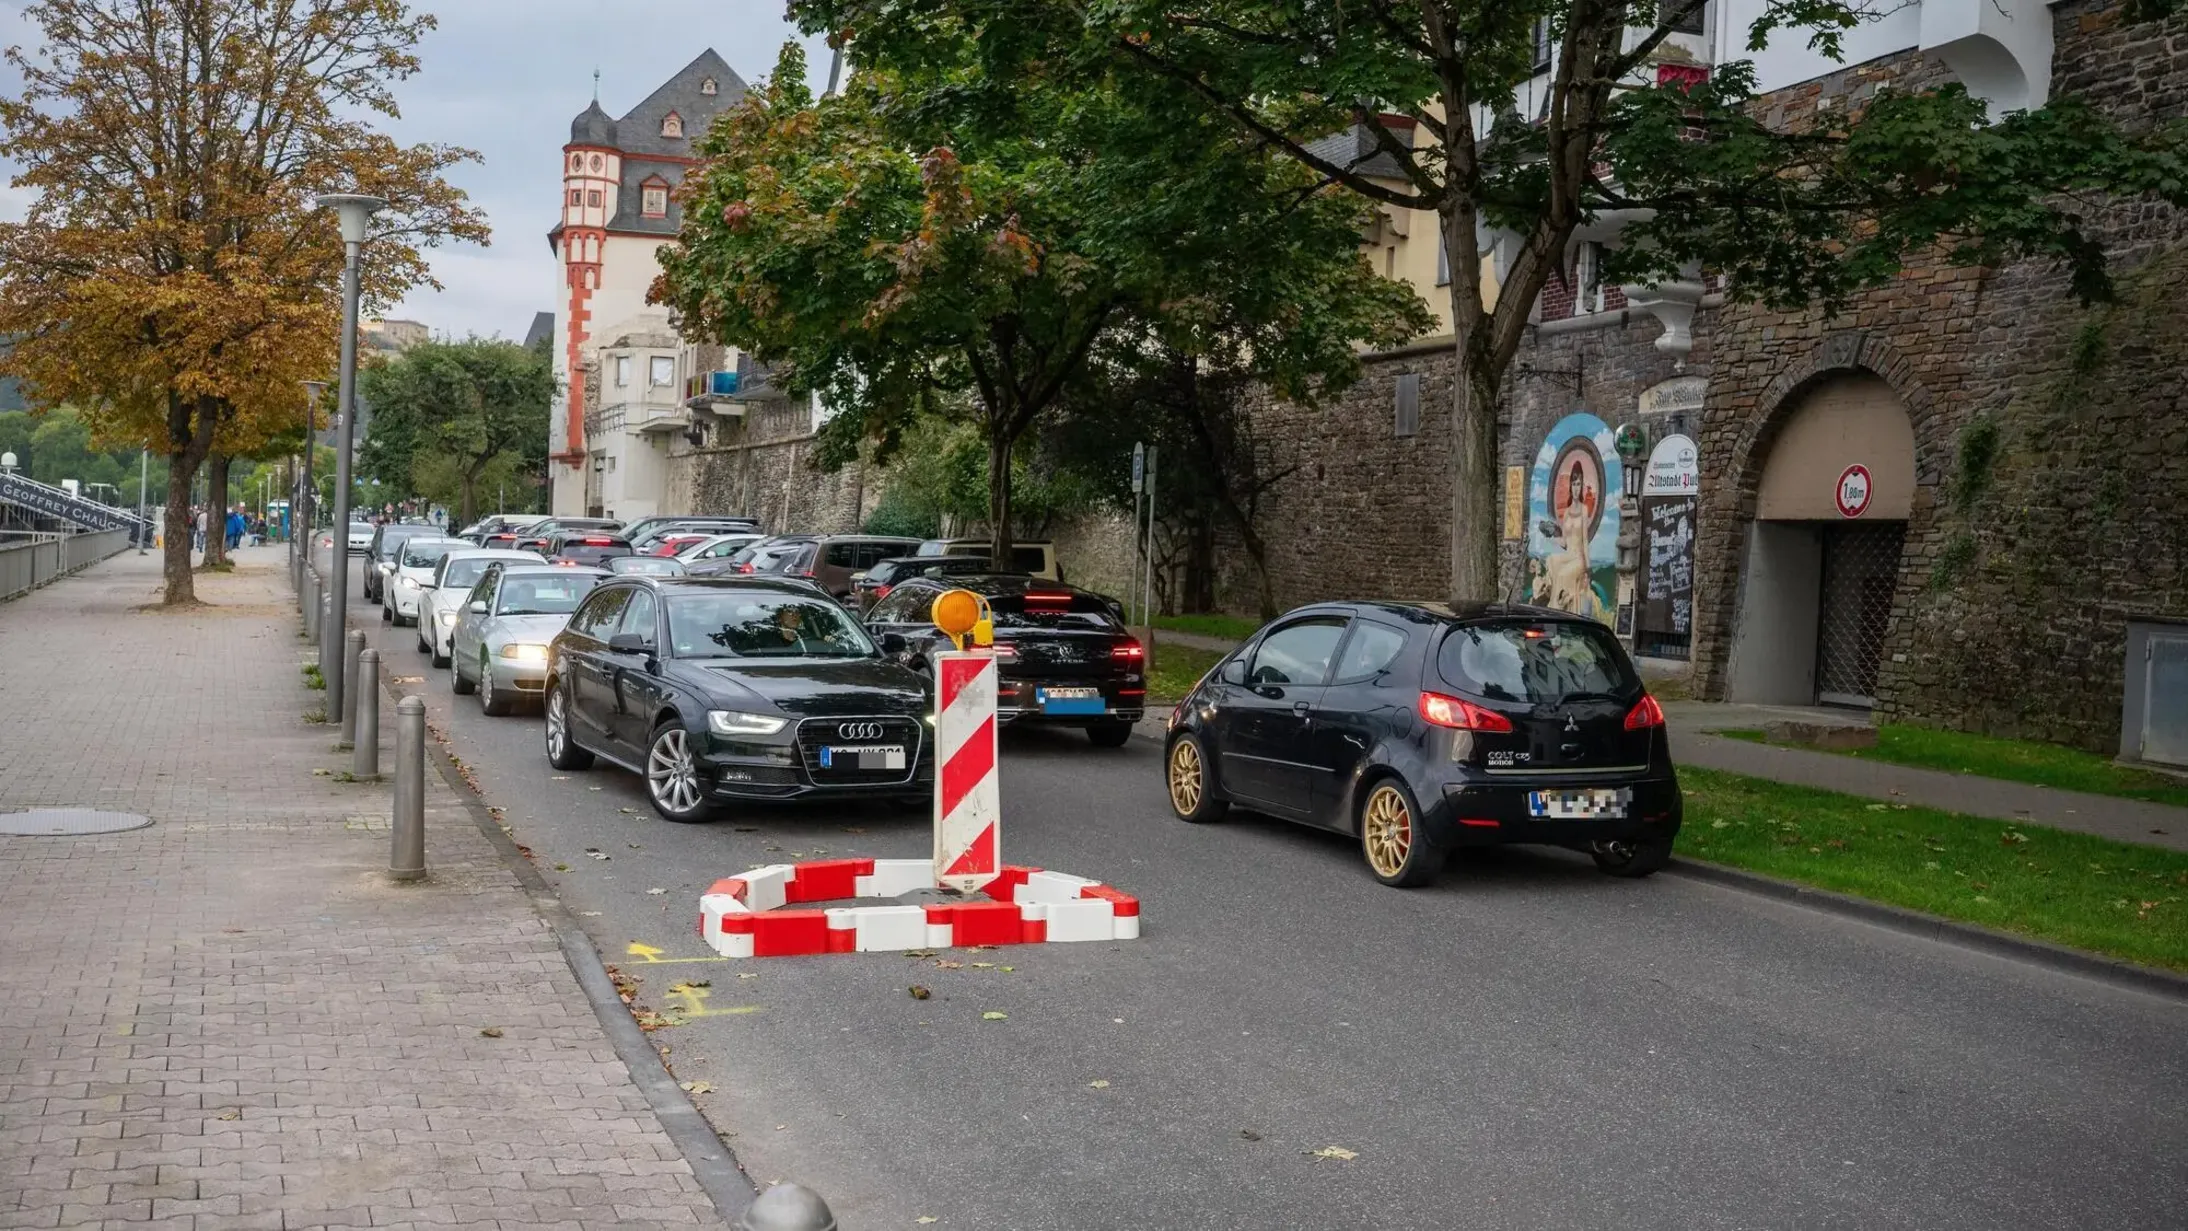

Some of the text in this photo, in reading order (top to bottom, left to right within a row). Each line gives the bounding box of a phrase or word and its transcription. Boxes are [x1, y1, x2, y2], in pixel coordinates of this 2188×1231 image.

[1648, 474, 1681, 487] Altstadt
[3, 484, 69, 514] GEOFFREY
[1487, 751, 1514, 760] COLT
